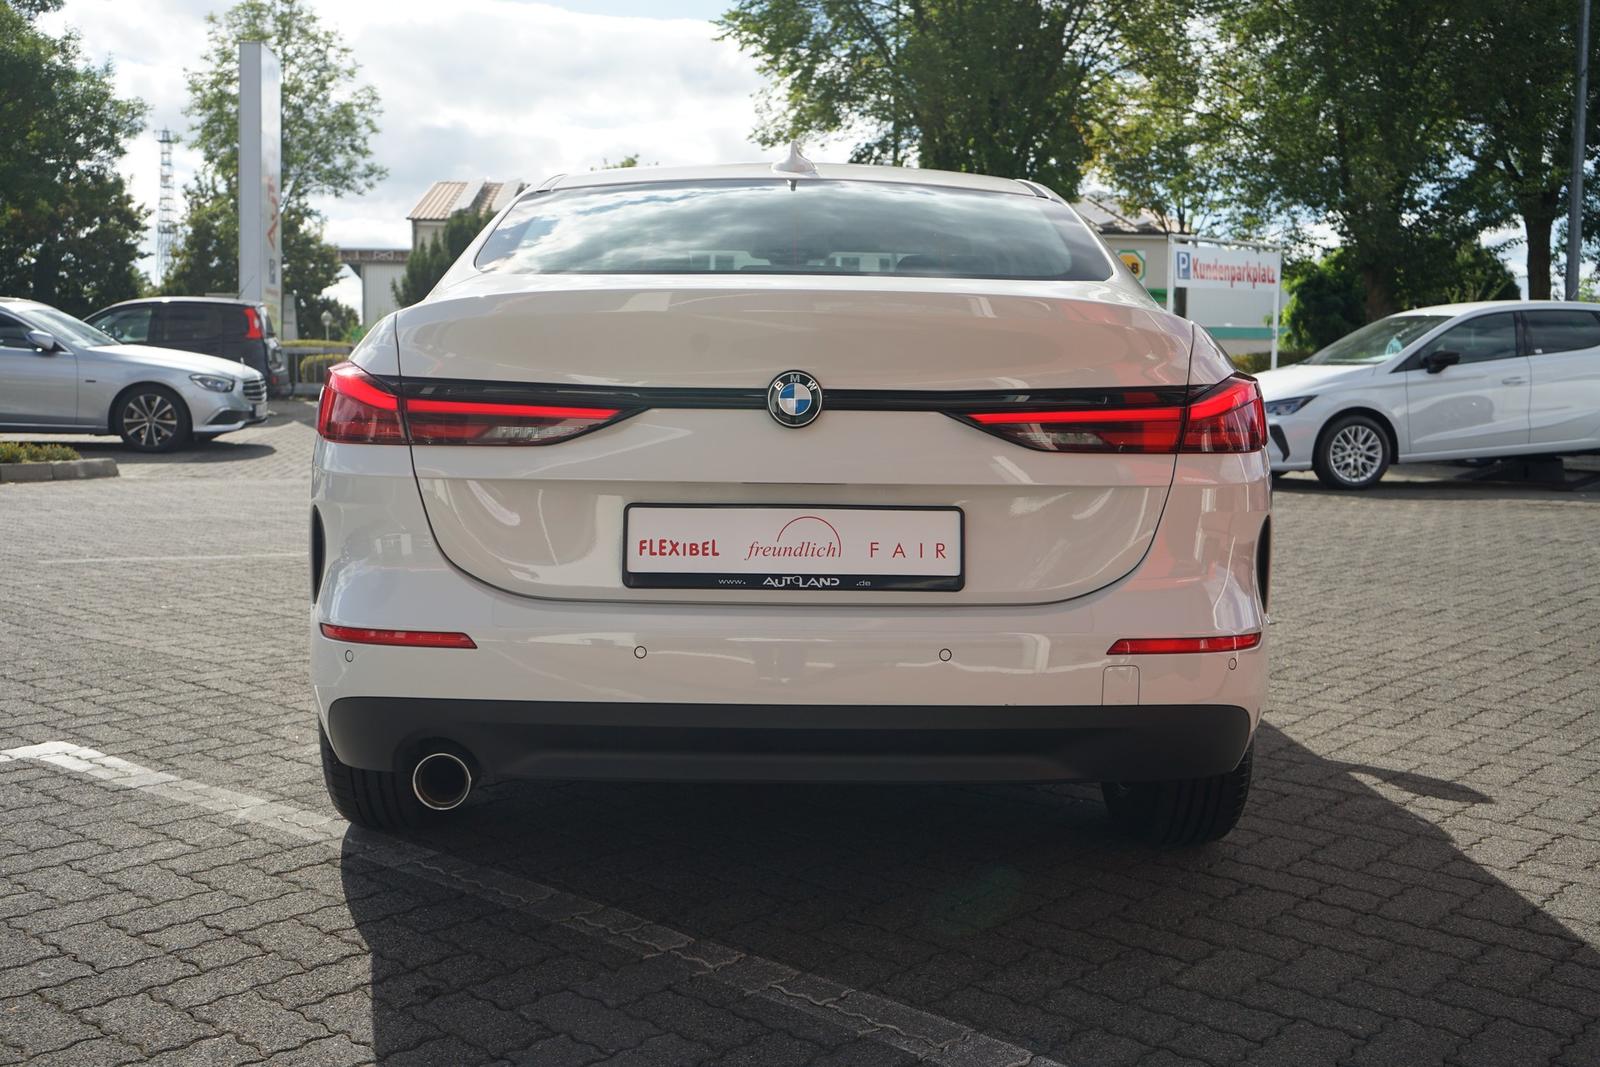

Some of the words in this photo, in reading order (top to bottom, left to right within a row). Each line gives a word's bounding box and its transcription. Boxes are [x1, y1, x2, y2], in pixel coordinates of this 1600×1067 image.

[1179, 253, 1189, 279] P
[1193, 257, 1276, 289] Kundenparkplatz
[774, 374, 817, 391] BMW
[639, 538, 720, 557] FLEXIBEL
[744, 540, 836, 561] freundlich
[870, 542, 946, 559] FAIR
[763, 575, 840, 588] AUTOLAND
